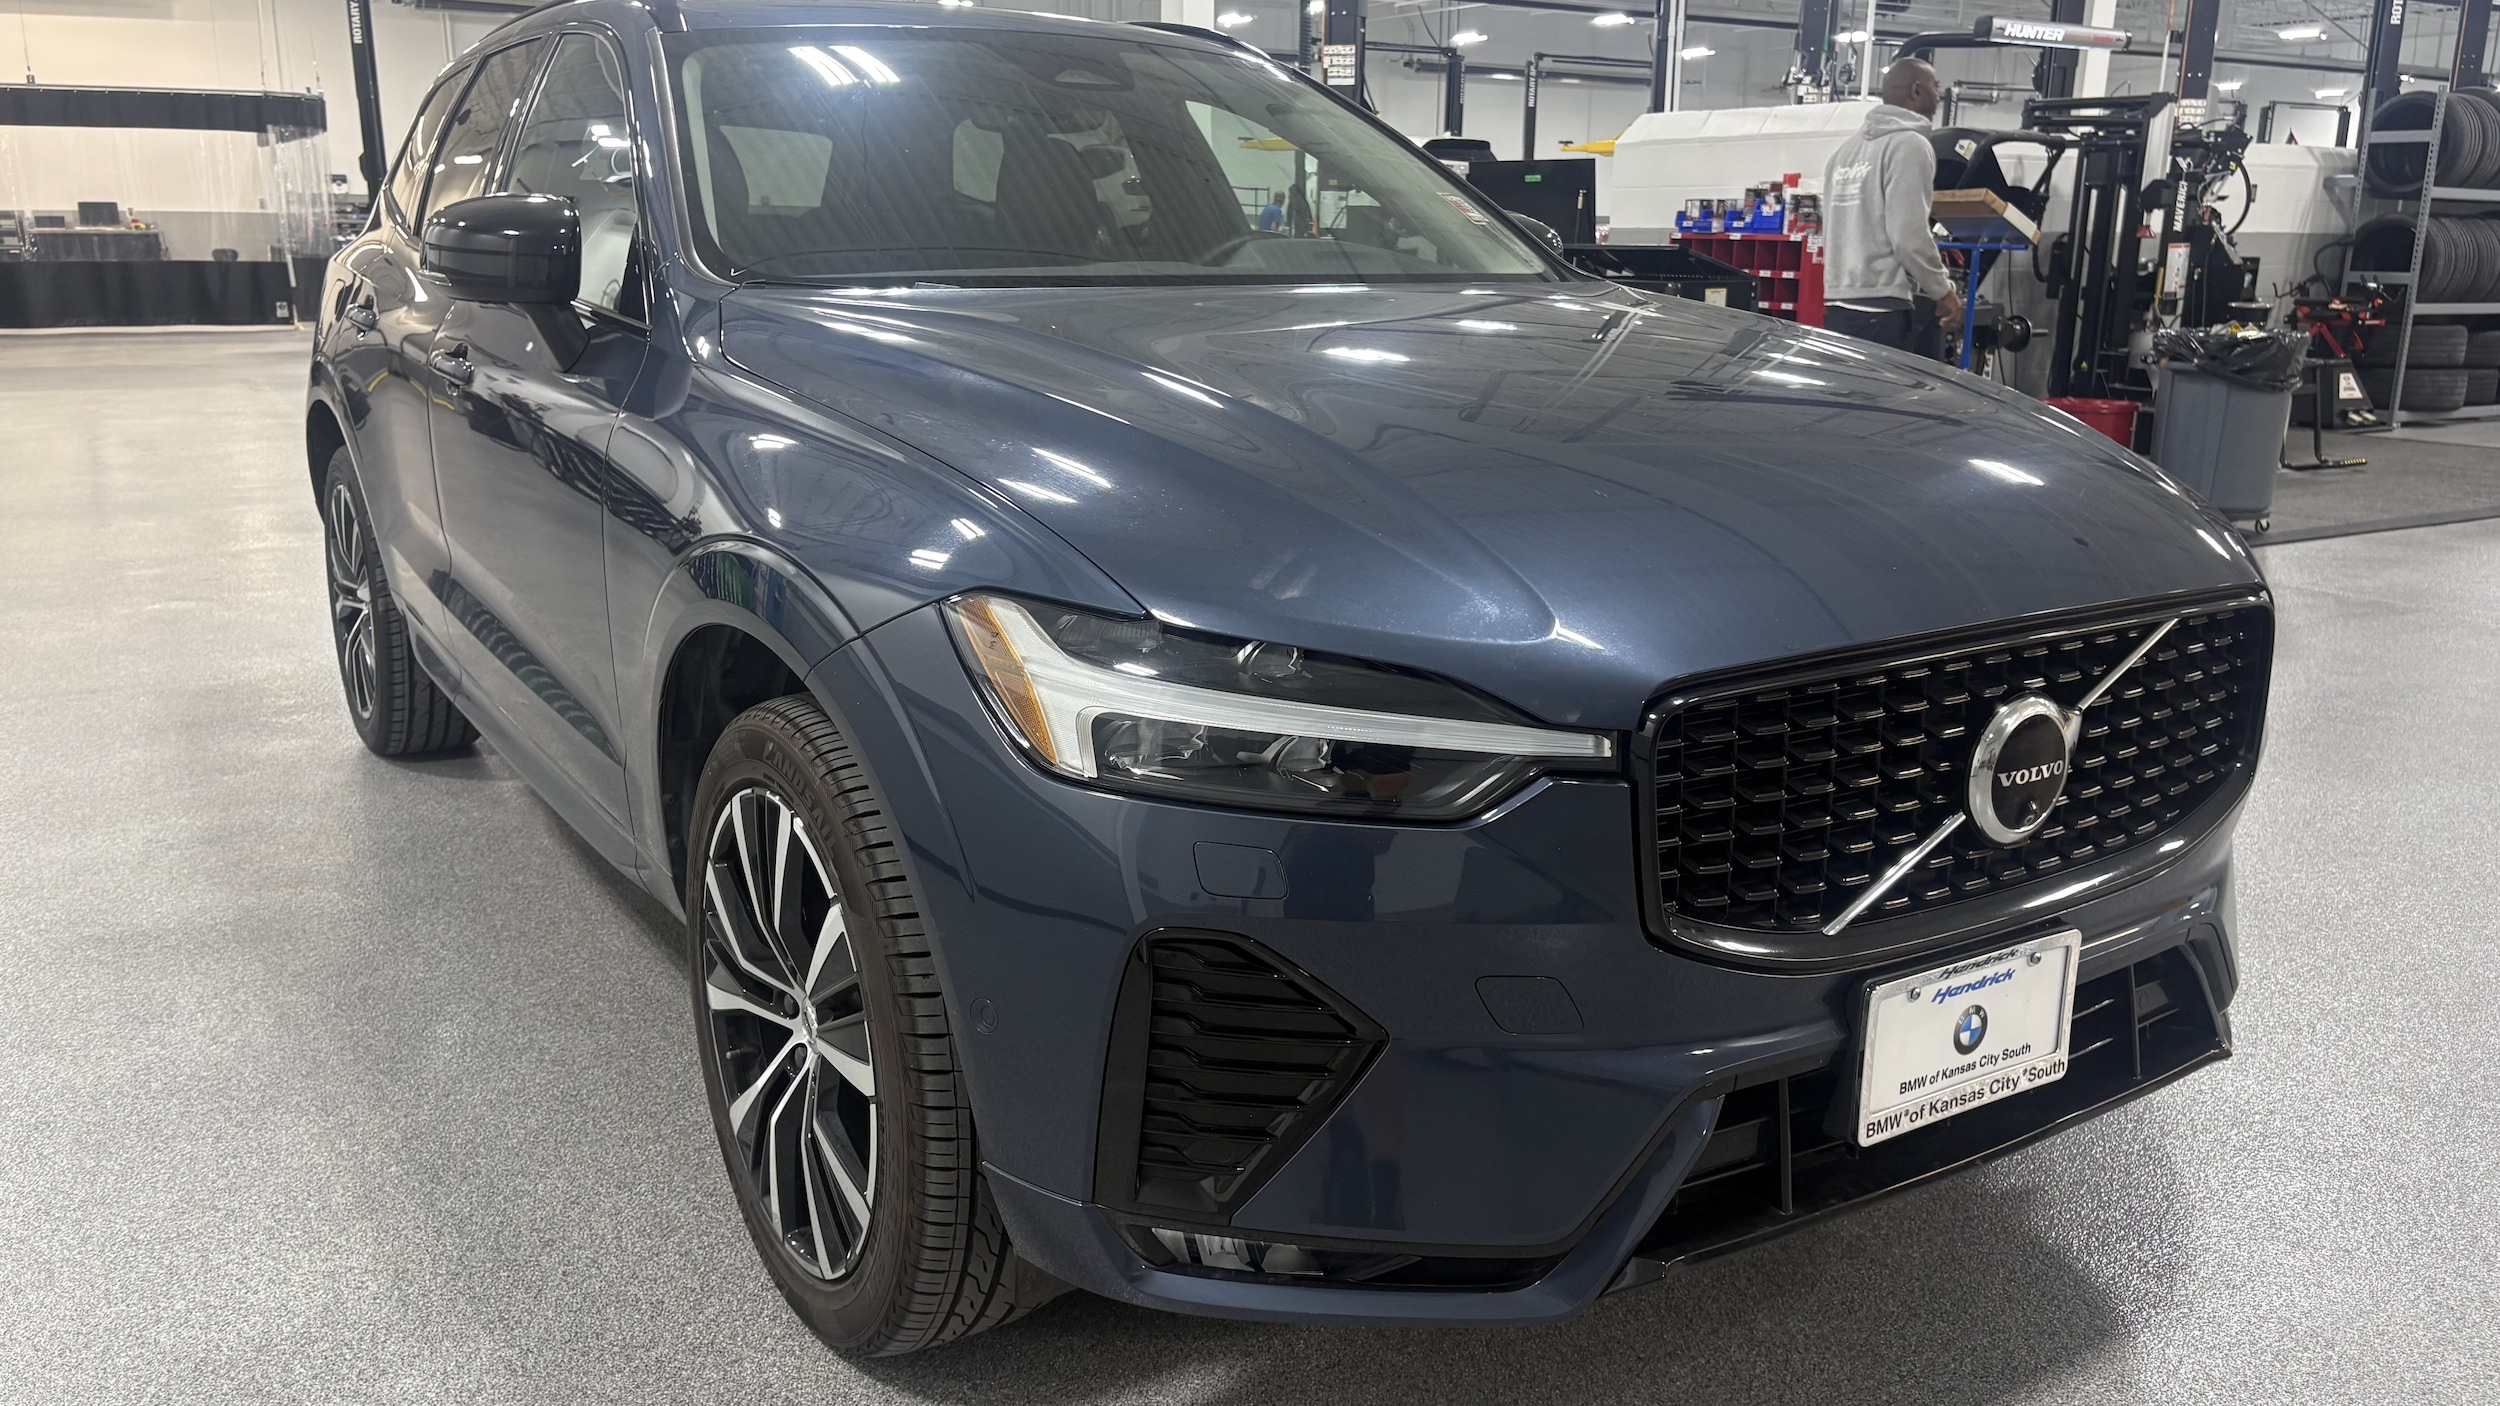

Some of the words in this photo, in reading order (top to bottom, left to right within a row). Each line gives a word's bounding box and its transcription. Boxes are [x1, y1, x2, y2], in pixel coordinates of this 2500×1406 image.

[349, 1, 363, 44] ROTARY
[2004, 23, 2065, 41] HUNTER
[1997, 760, 2064, 787] VOLVO
[762, 740, 838, 859] LANDSAIL
[1938, 948, 2017, 979] Hendrick
[1931, 968, 2016, 1004] Hendrick
[1899, 1074, 1928, 1095] BMW
[1929, 1068, 1940, 1084] of
[1941, 1060, 1977, 1079] Kansas
[1979, 1053, 2000, 1068] City
[2001, 1042, 2031, 1061] South
[1909, 1105, 1926, 1124] of
[1929, 1091, 1985, 1116] Kansas
[1989, 1075, 2021, 1096] City
